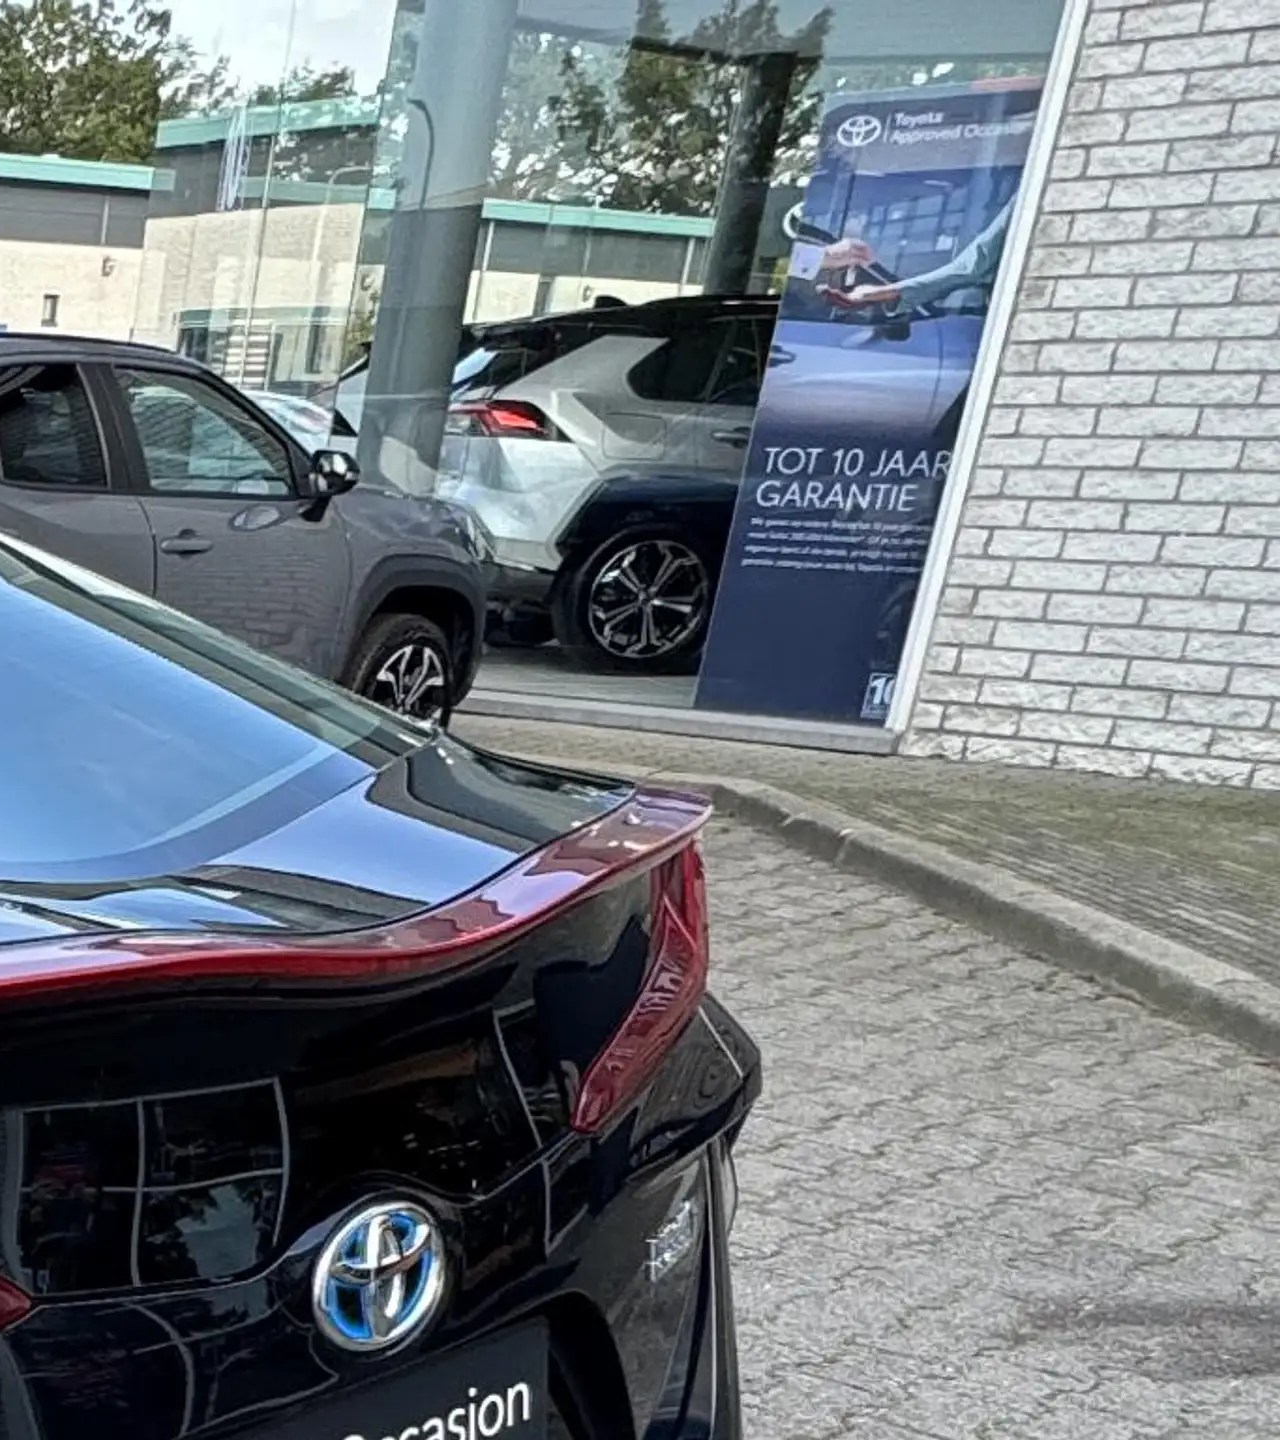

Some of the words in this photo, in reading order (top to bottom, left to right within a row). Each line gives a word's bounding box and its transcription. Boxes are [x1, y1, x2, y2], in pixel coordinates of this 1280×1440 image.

[894, 111, 945, 128] Toyota
[764, 446, 825, 475] TOT
[832, 449, 865, 477] 10
[869, 450, 952, 478] JAAR
[755, 479, 919, 512] GARANTIE
